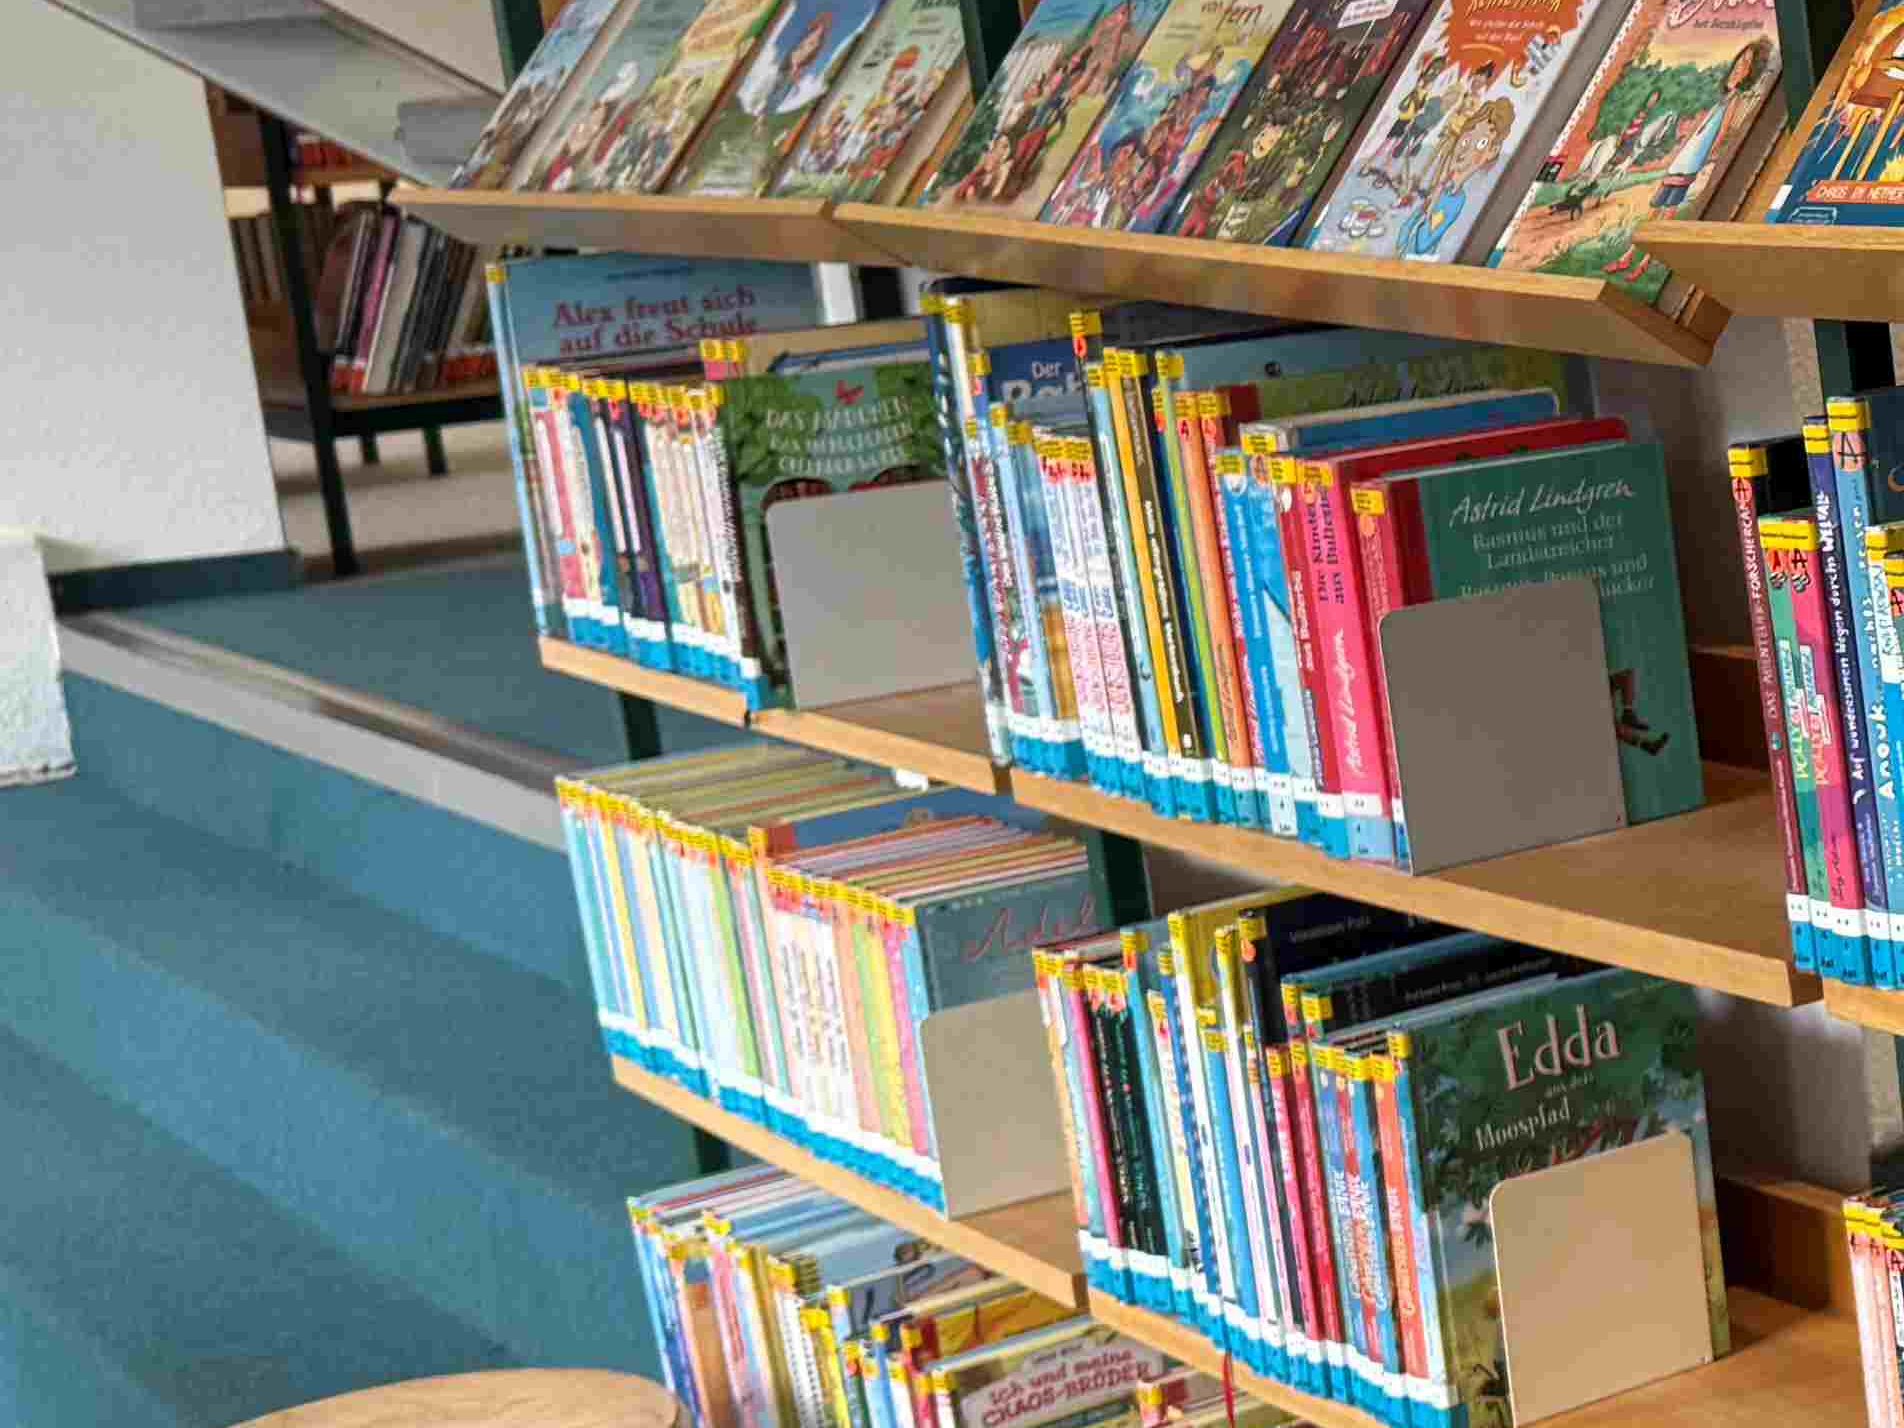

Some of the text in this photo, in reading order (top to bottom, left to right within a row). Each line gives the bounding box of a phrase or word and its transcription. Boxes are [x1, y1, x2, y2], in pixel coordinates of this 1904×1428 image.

[553, 301, 612, 329] Alex
[1449, 478, 1637, 528] Astrid Lindgren
[1496, 1003, 1621, 1091] Edda
[1475, 1096, 1572, 1153] Moospfad
